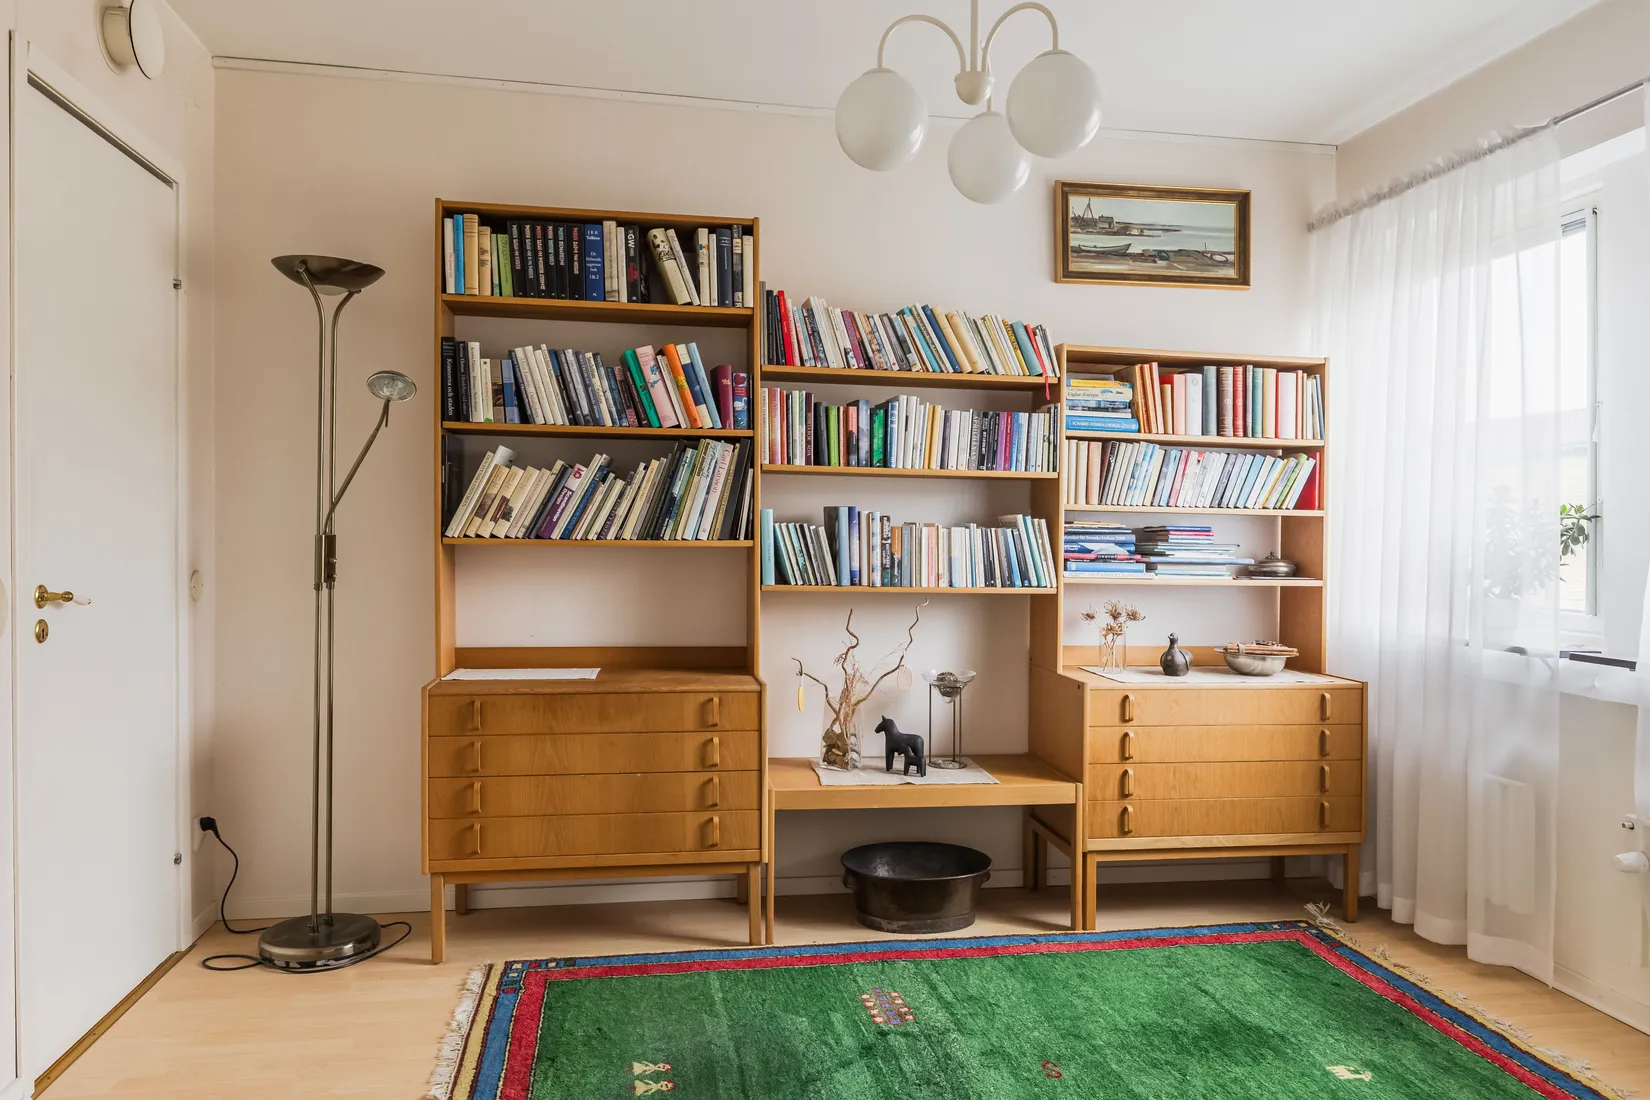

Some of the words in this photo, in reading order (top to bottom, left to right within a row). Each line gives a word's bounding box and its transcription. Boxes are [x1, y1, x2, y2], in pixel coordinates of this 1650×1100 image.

[628, 234, 635, 248] GW
[720, 449, 730, 466] Carl
[712, 466, 725, 493] Larsson
[556, 488, 565, 505] Design
[553, 490, 572, 521] Scandinavian
